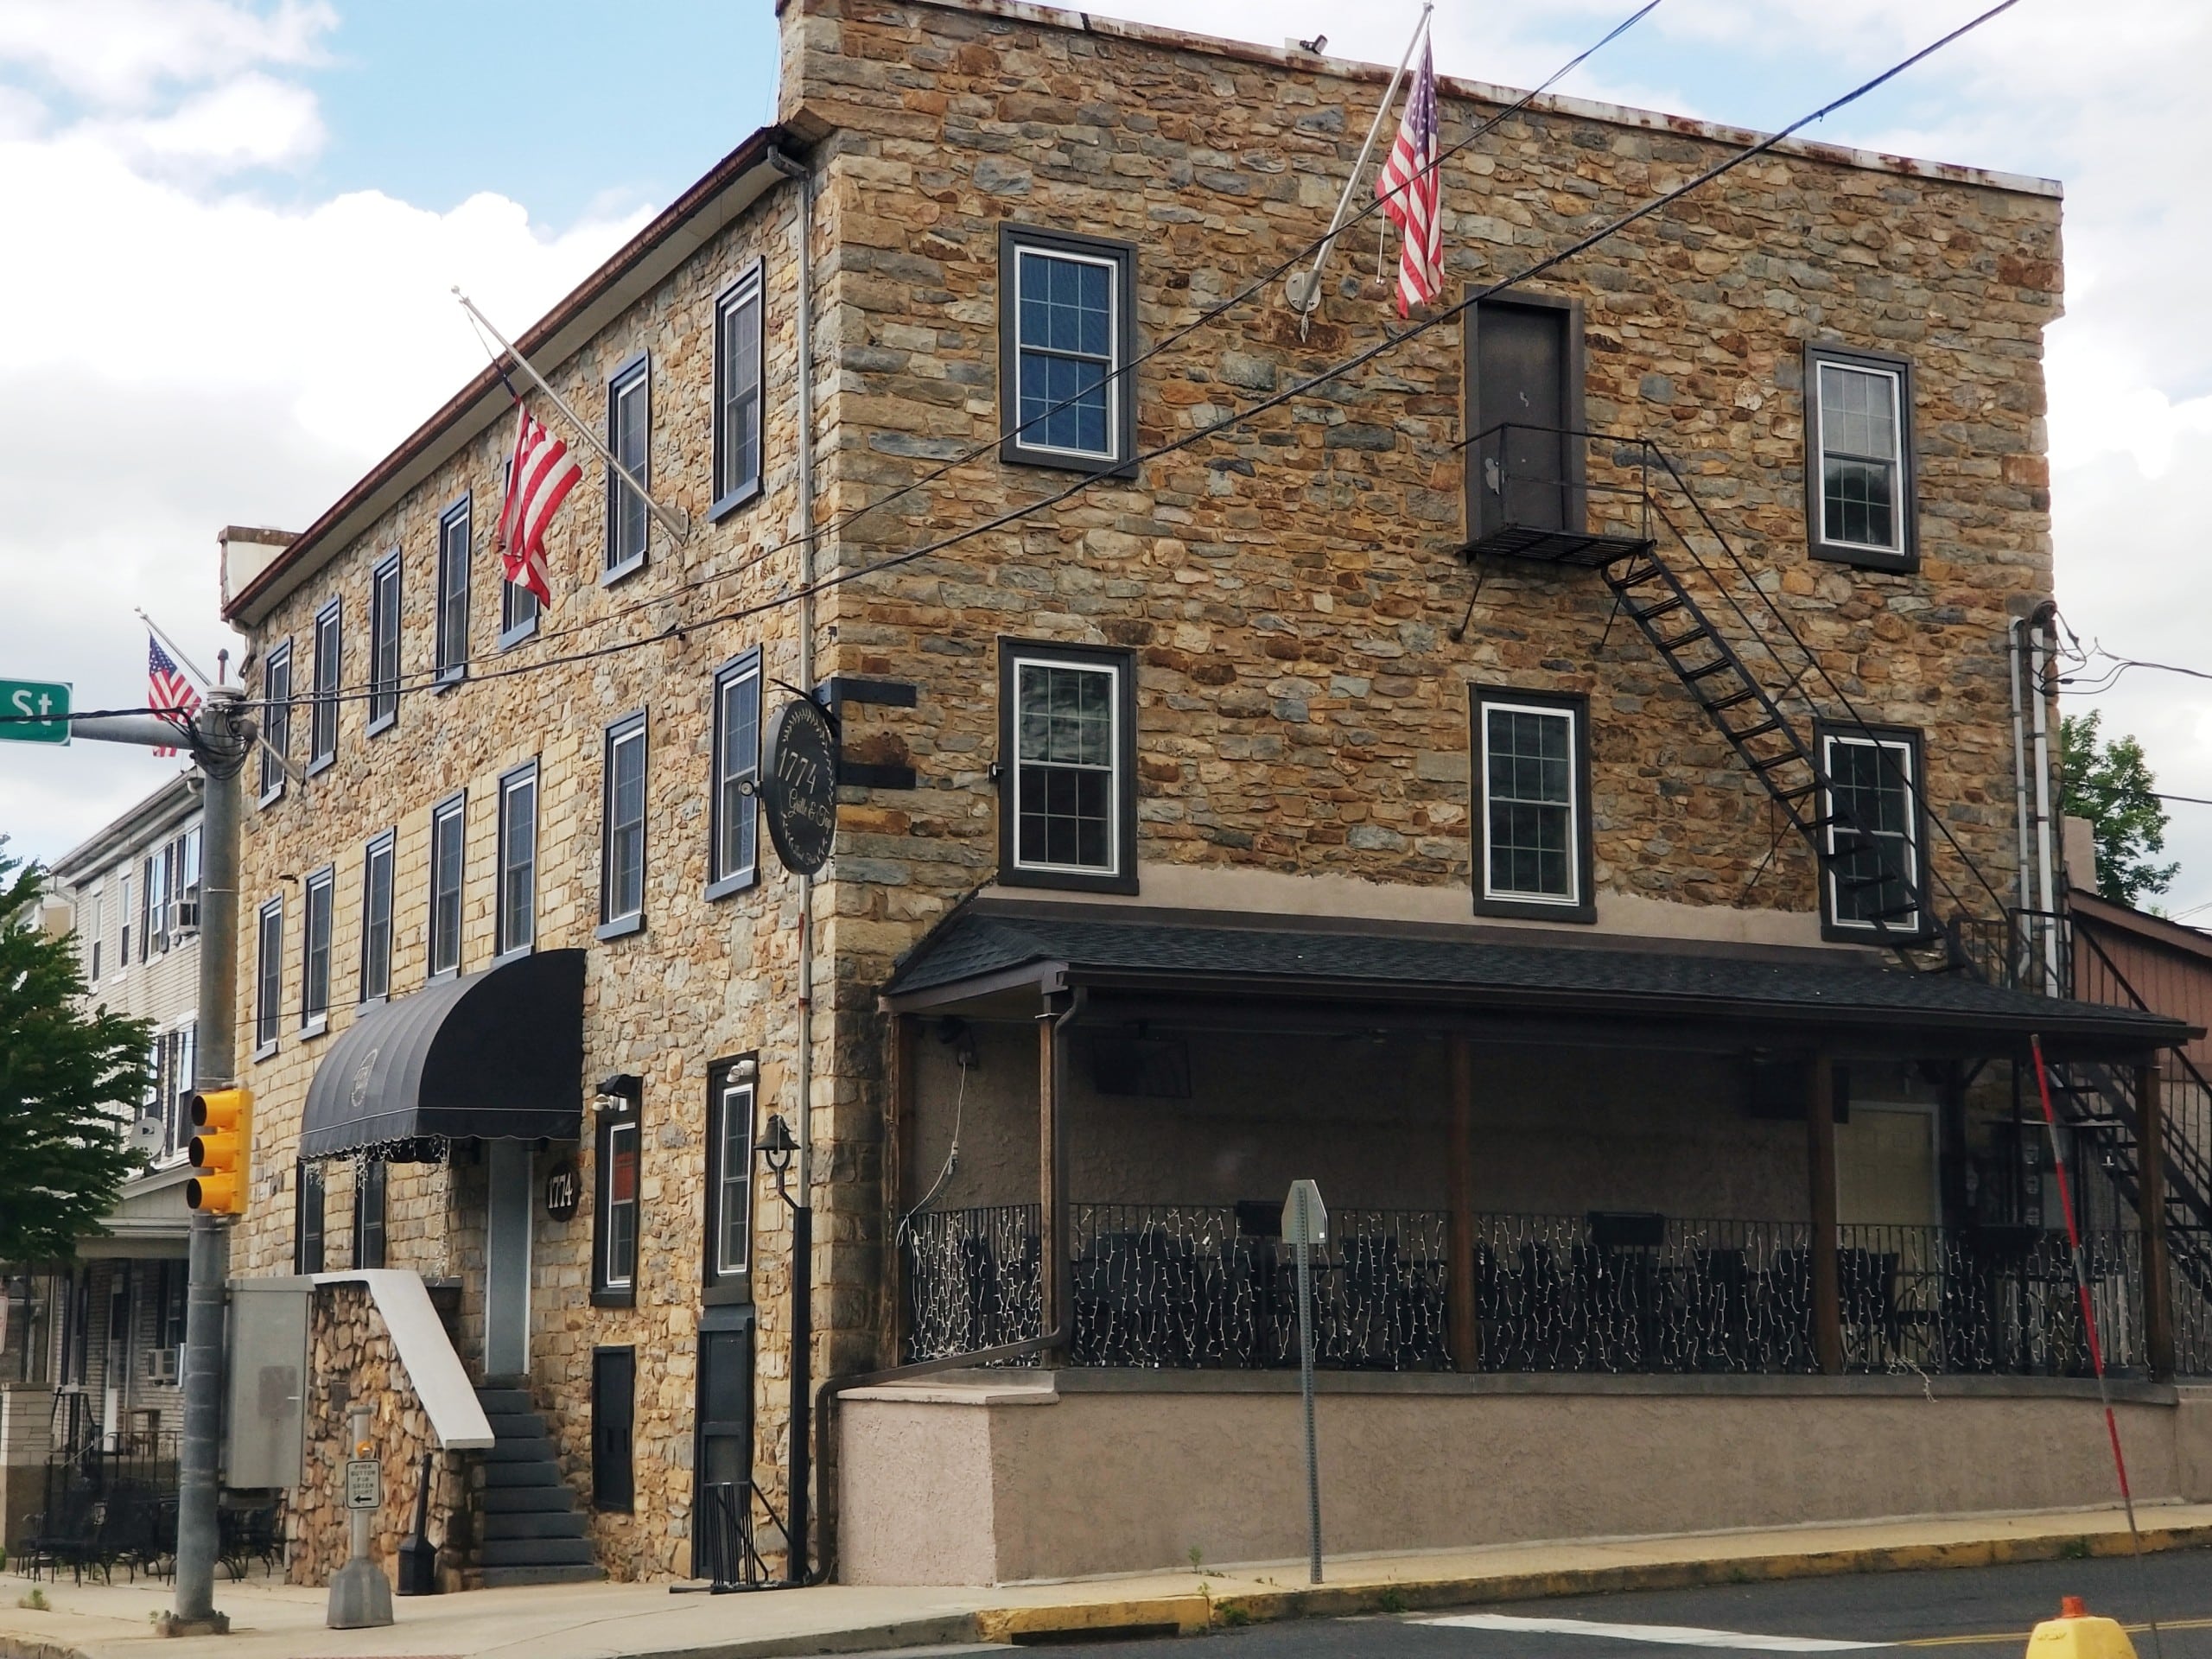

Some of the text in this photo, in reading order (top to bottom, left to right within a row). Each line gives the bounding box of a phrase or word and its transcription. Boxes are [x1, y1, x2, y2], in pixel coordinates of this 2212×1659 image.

[12, 690, 53, 727] St
[779, 747, 817, 794] 1774
[548, 1173, 573, 1209] 1774
